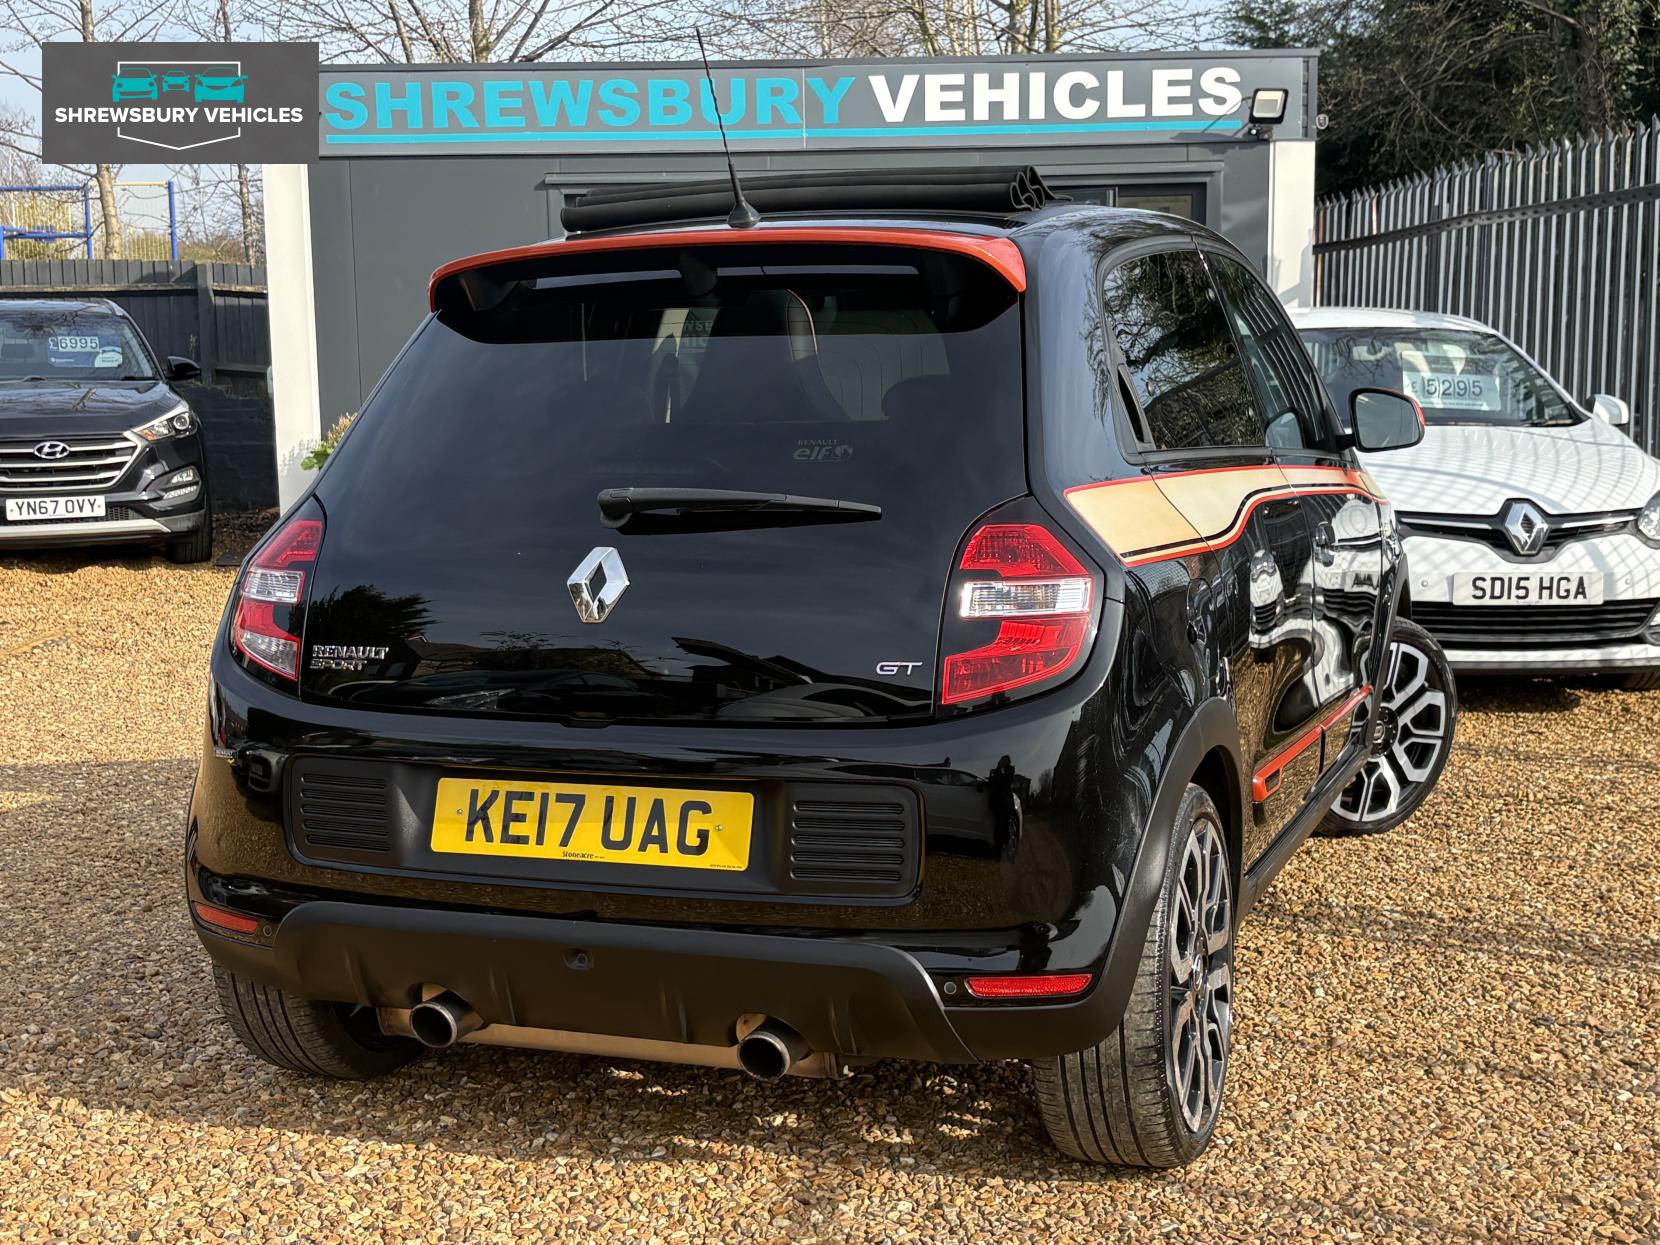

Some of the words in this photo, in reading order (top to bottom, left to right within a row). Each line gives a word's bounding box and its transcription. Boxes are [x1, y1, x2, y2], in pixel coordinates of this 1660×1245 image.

[325, 77, 856, 130] SHREWSBURY
[868, 67, 1241, 122] VEHICLES
[15, 500, 59, 516] YN67
[65, 498, 96, 514] OVY
[1471, 576, 1530, 600] SD15
[1538, 576, 1587, 600] HGA
[312, 645, 389, 659] RENAULT
[310, 659, 367, 671] SPORT
[876, 661, 923, 676] GT
[464, 788, 586, 848] KE17
[600, 795, 713, 856] UAG
[562, 850, 594, 859] Stoneacre
